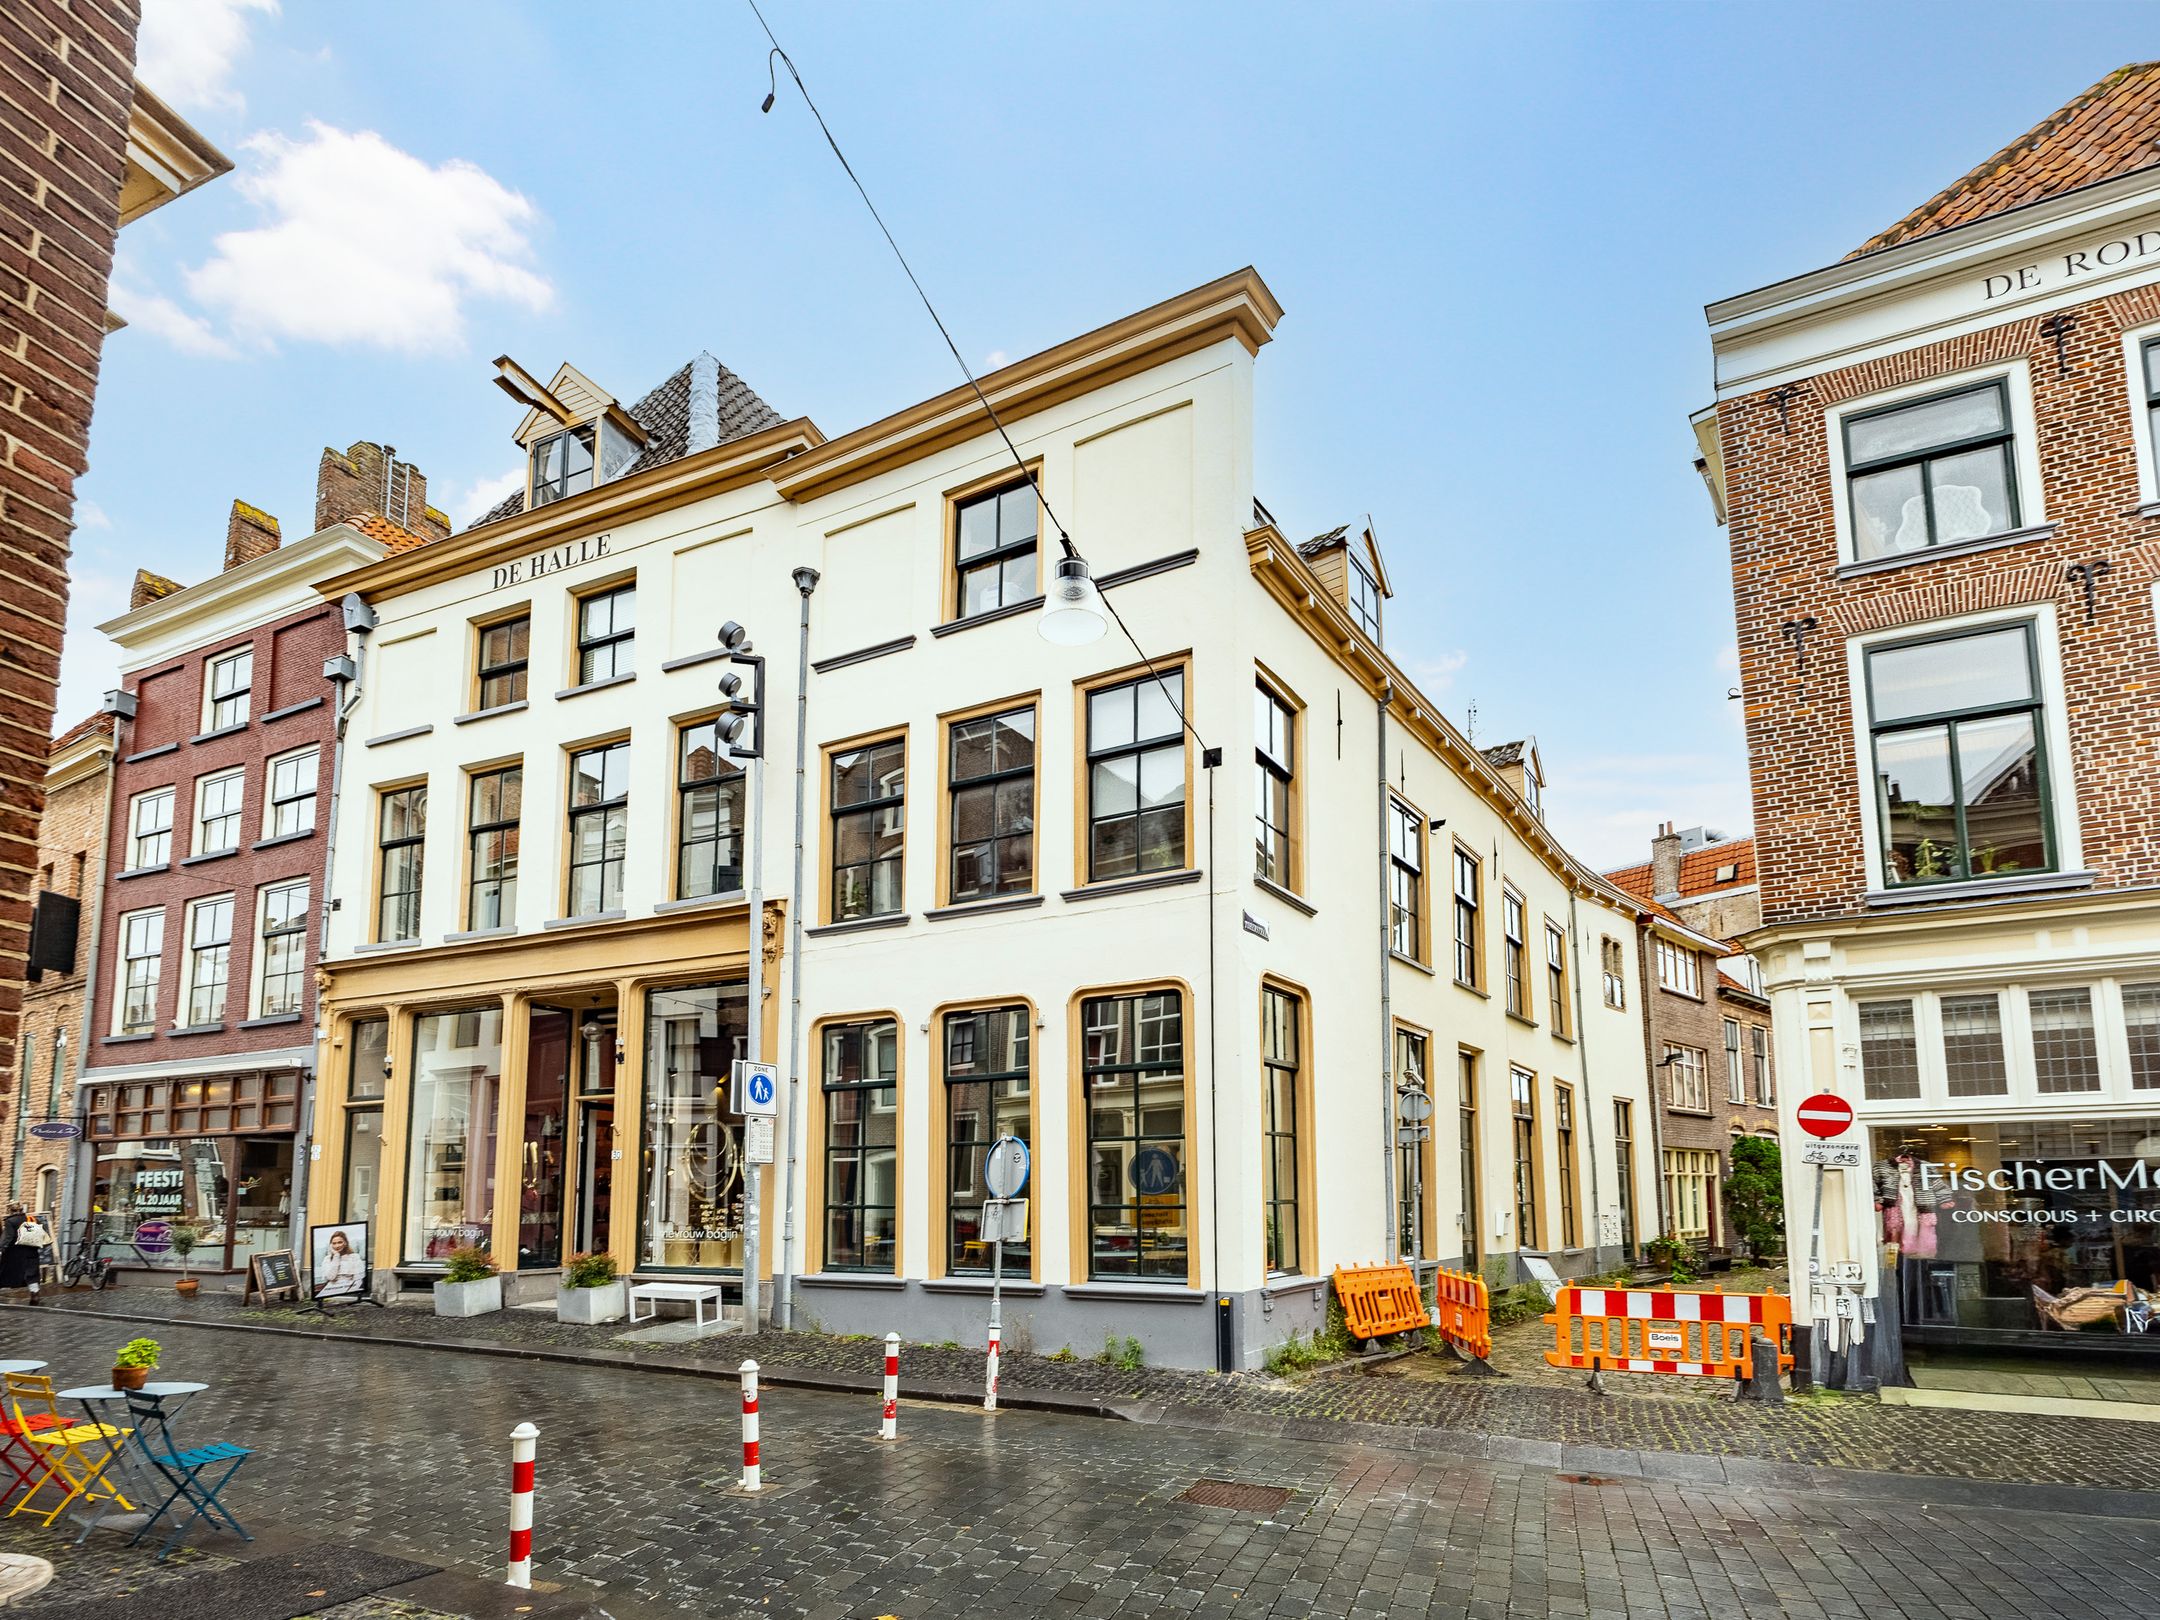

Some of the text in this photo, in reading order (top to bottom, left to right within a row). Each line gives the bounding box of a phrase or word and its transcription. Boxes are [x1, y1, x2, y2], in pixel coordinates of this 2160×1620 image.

[1982, 230, 2160, 301] DE ROD
[493, 533, 611, 589] DE HALLE
[1805, 1143, 1859, 1151] uitgezonderd
[136, 1170, 185, 1188] FEEST!
[1919, 1158, 2160, 1192] FischerM
[135, 1194, 182, 1206] AL 20 JAAR
[1952, 1209, 2078, 1223] CONSCIOUS
[706, 1227, 738, 1241] bagijn
